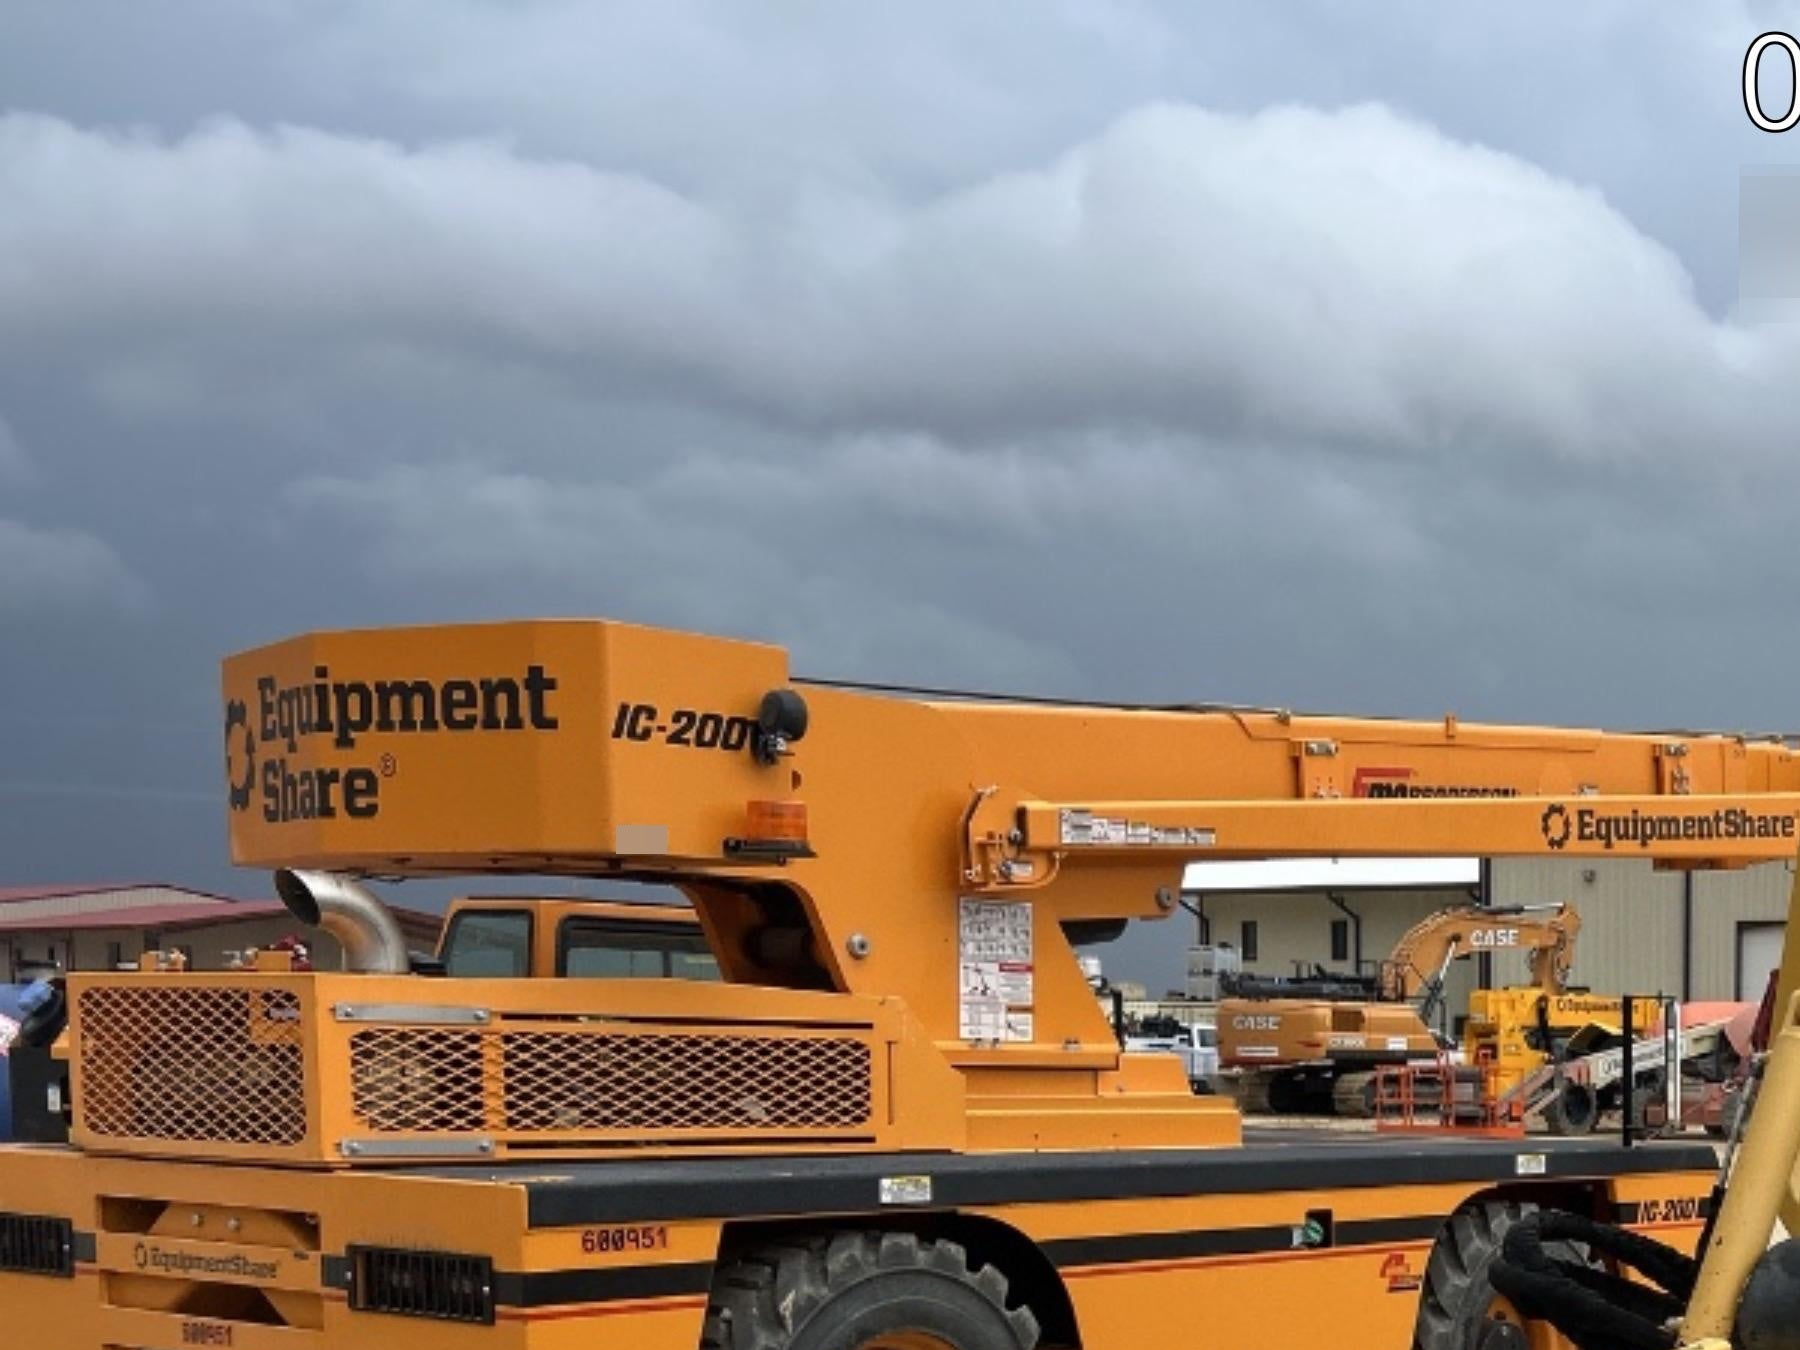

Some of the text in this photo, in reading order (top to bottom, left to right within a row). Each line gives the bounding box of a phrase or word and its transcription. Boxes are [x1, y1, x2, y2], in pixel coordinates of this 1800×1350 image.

[257, 665, 559, 751] Equipment
[1577, 809, 1795, 849] EquipmentShare
[1470, 929, 1520, 946] CASE
[1232, 1015, 1282, 1030] CASE
